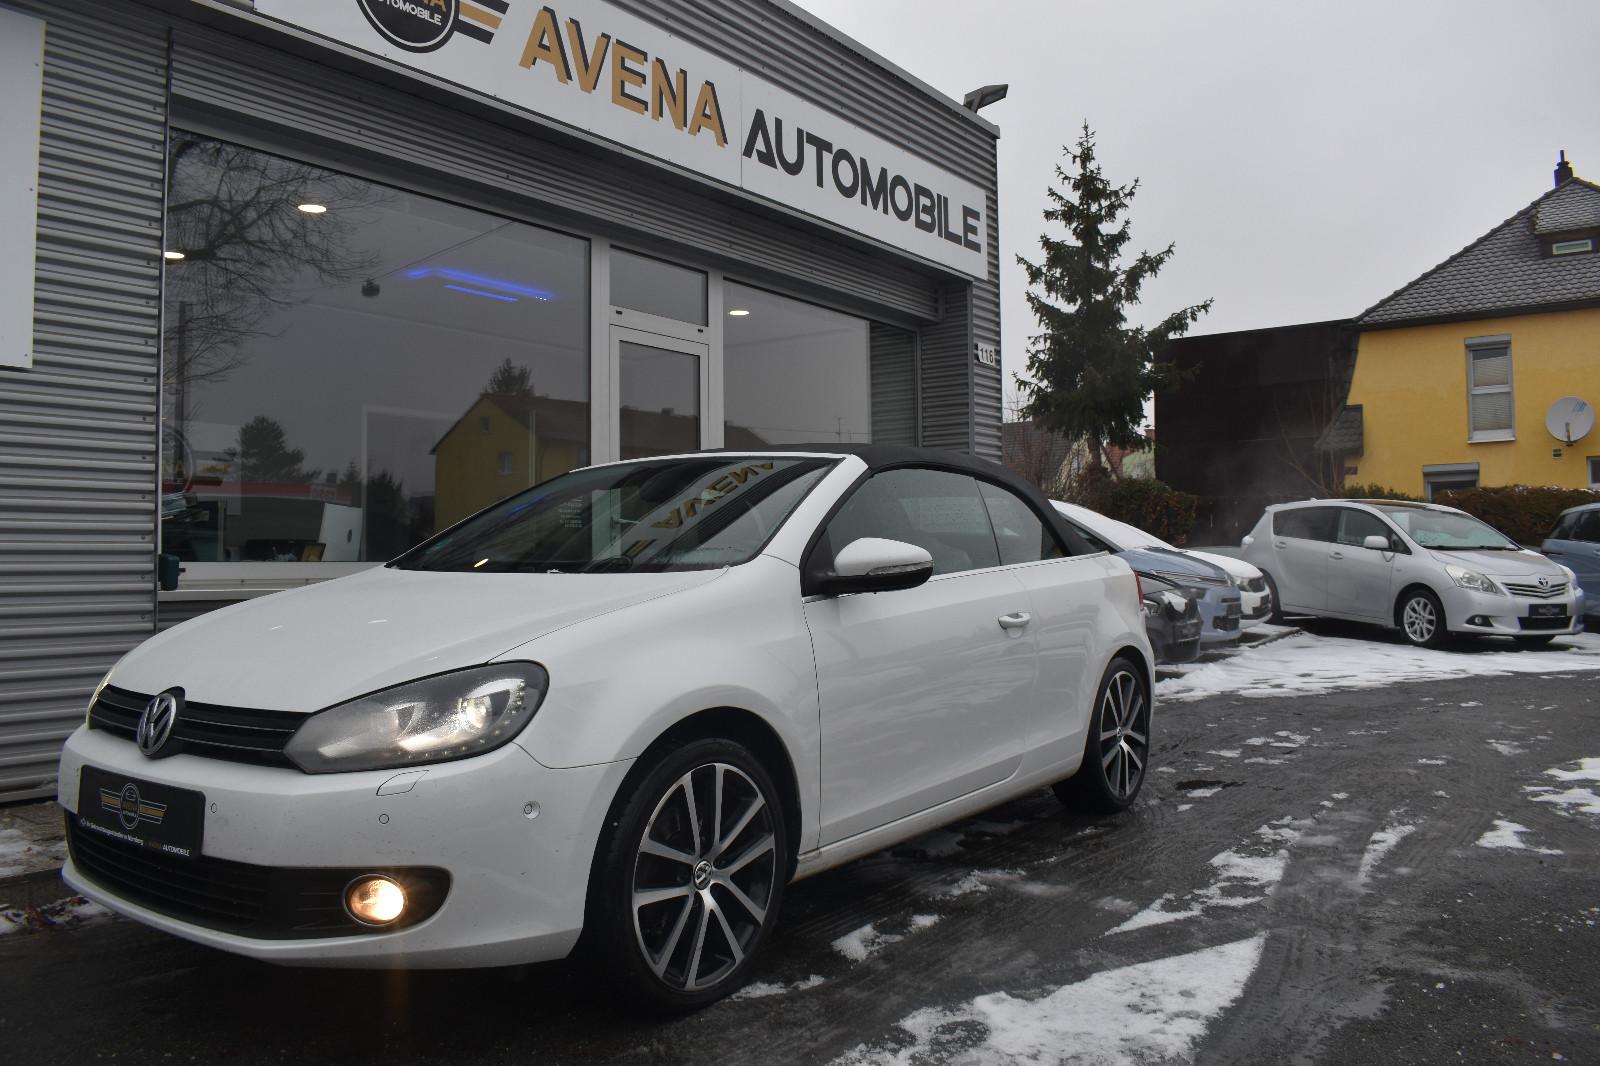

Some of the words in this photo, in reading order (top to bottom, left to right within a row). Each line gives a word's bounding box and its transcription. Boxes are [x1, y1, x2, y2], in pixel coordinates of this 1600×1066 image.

[379, 0, 442, 26] OMOBILE
[519, 5, 727, 148] AVENA
[743, 108, 981, 253] AUTOMOBILE
[980, 347, 994, 363] 116
